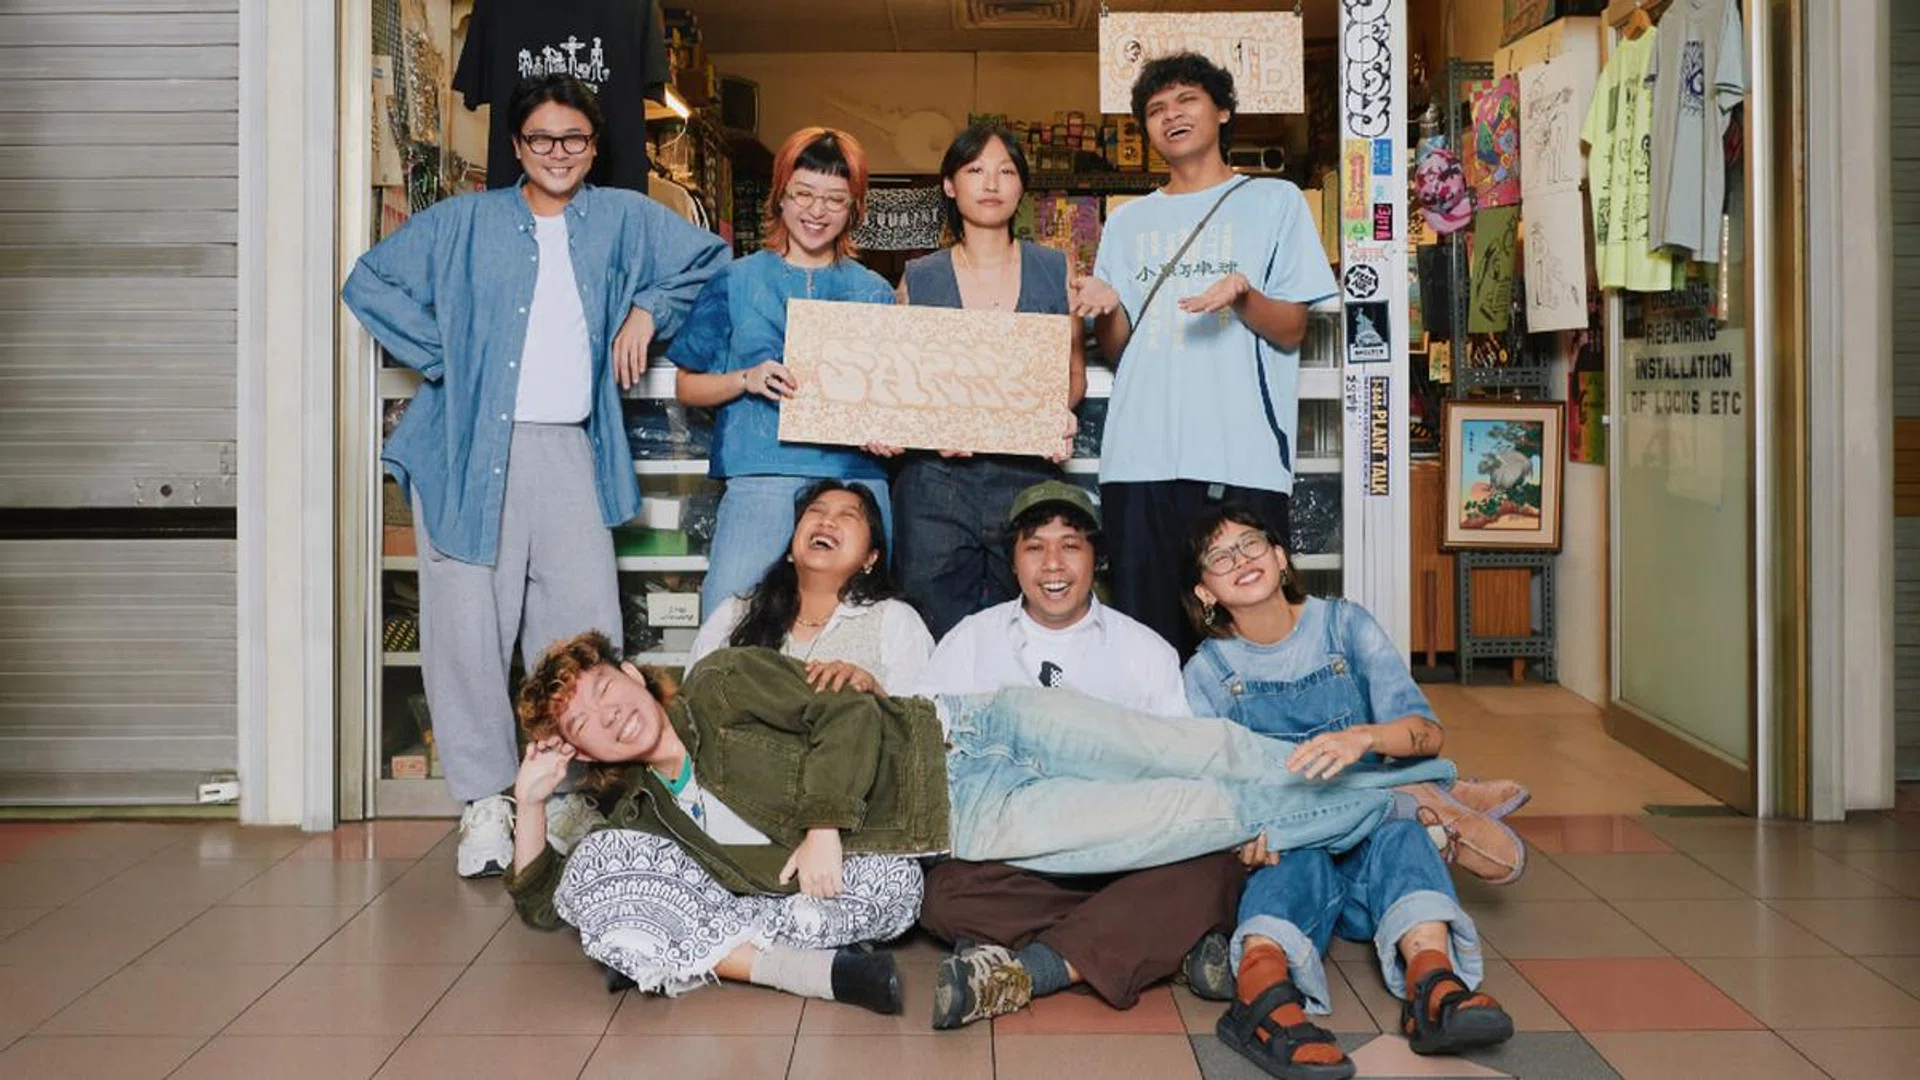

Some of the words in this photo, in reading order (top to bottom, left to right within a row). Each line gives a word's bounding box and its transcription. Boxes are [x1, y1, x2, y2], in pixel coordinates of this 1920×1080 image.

[1646, 318, 1717, 345] REPAIRING
[1635, 352, 1733, 380] INSTALLATION
[1631, 391, 1647, 414] OF
[1655, 391, 1701, 414] LOCKS
[1710, 391, 1742, 415] ETC
[1371, 409, 1388, 456] PLANT
[1371, 461, 1388, 495] TALK
